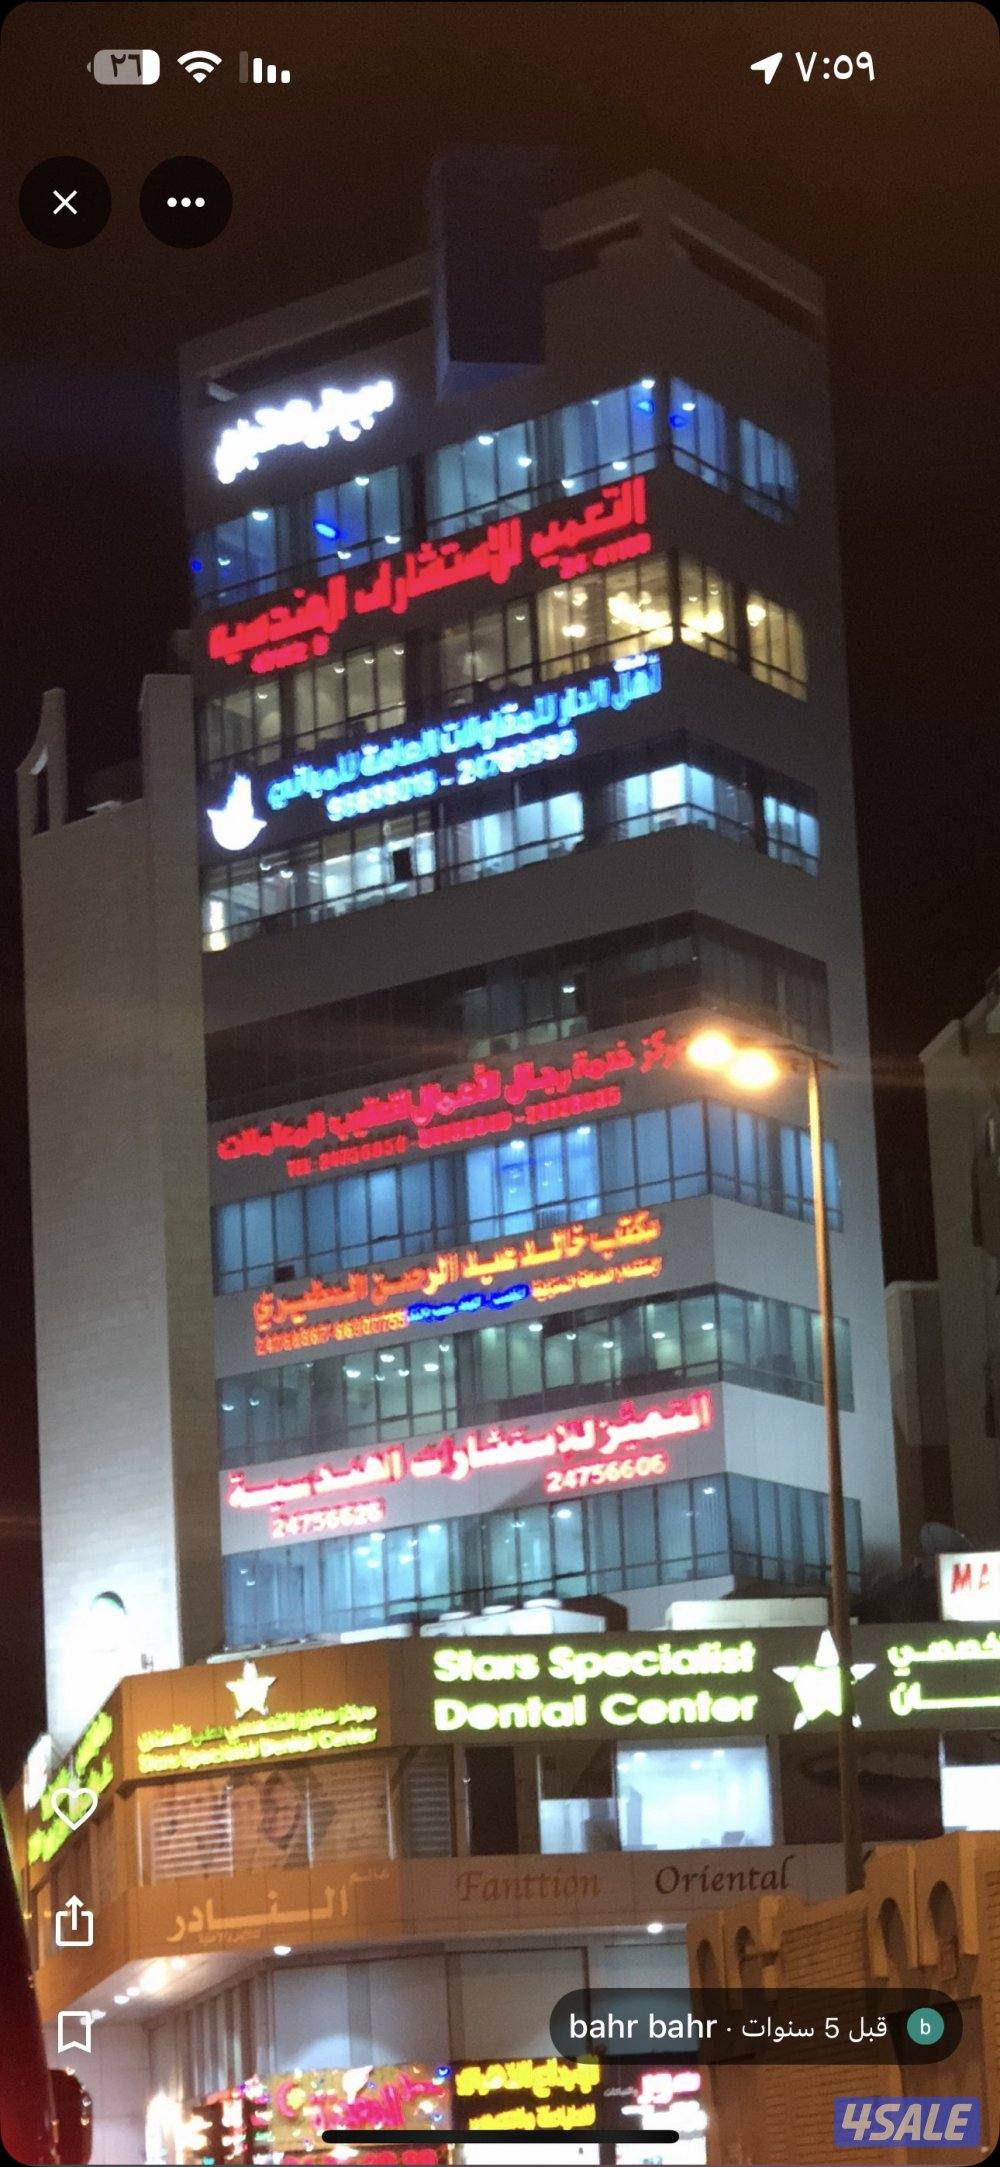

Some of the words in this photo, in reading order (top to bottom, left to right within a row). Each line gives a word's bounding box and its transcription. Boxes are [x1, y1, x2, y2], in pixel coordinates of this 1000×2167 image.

[518, 1223, 587, 1268] خالد
[588, 1209, 662, 1261] مكتب
[461, 1245, 518, 1286] عبد
[228, 1442, 406, 1513] الهندسية
[433, 1648, 540, 1682] Stars
[548, 1640, 756, 1685] Specialist
[433, 1694, 588, 1731] Dental
[599, 1689, 759, 1726] Center
[655, 1855, 795, 1895] Oriental
[166, 1885, 350, 1944] النادر
